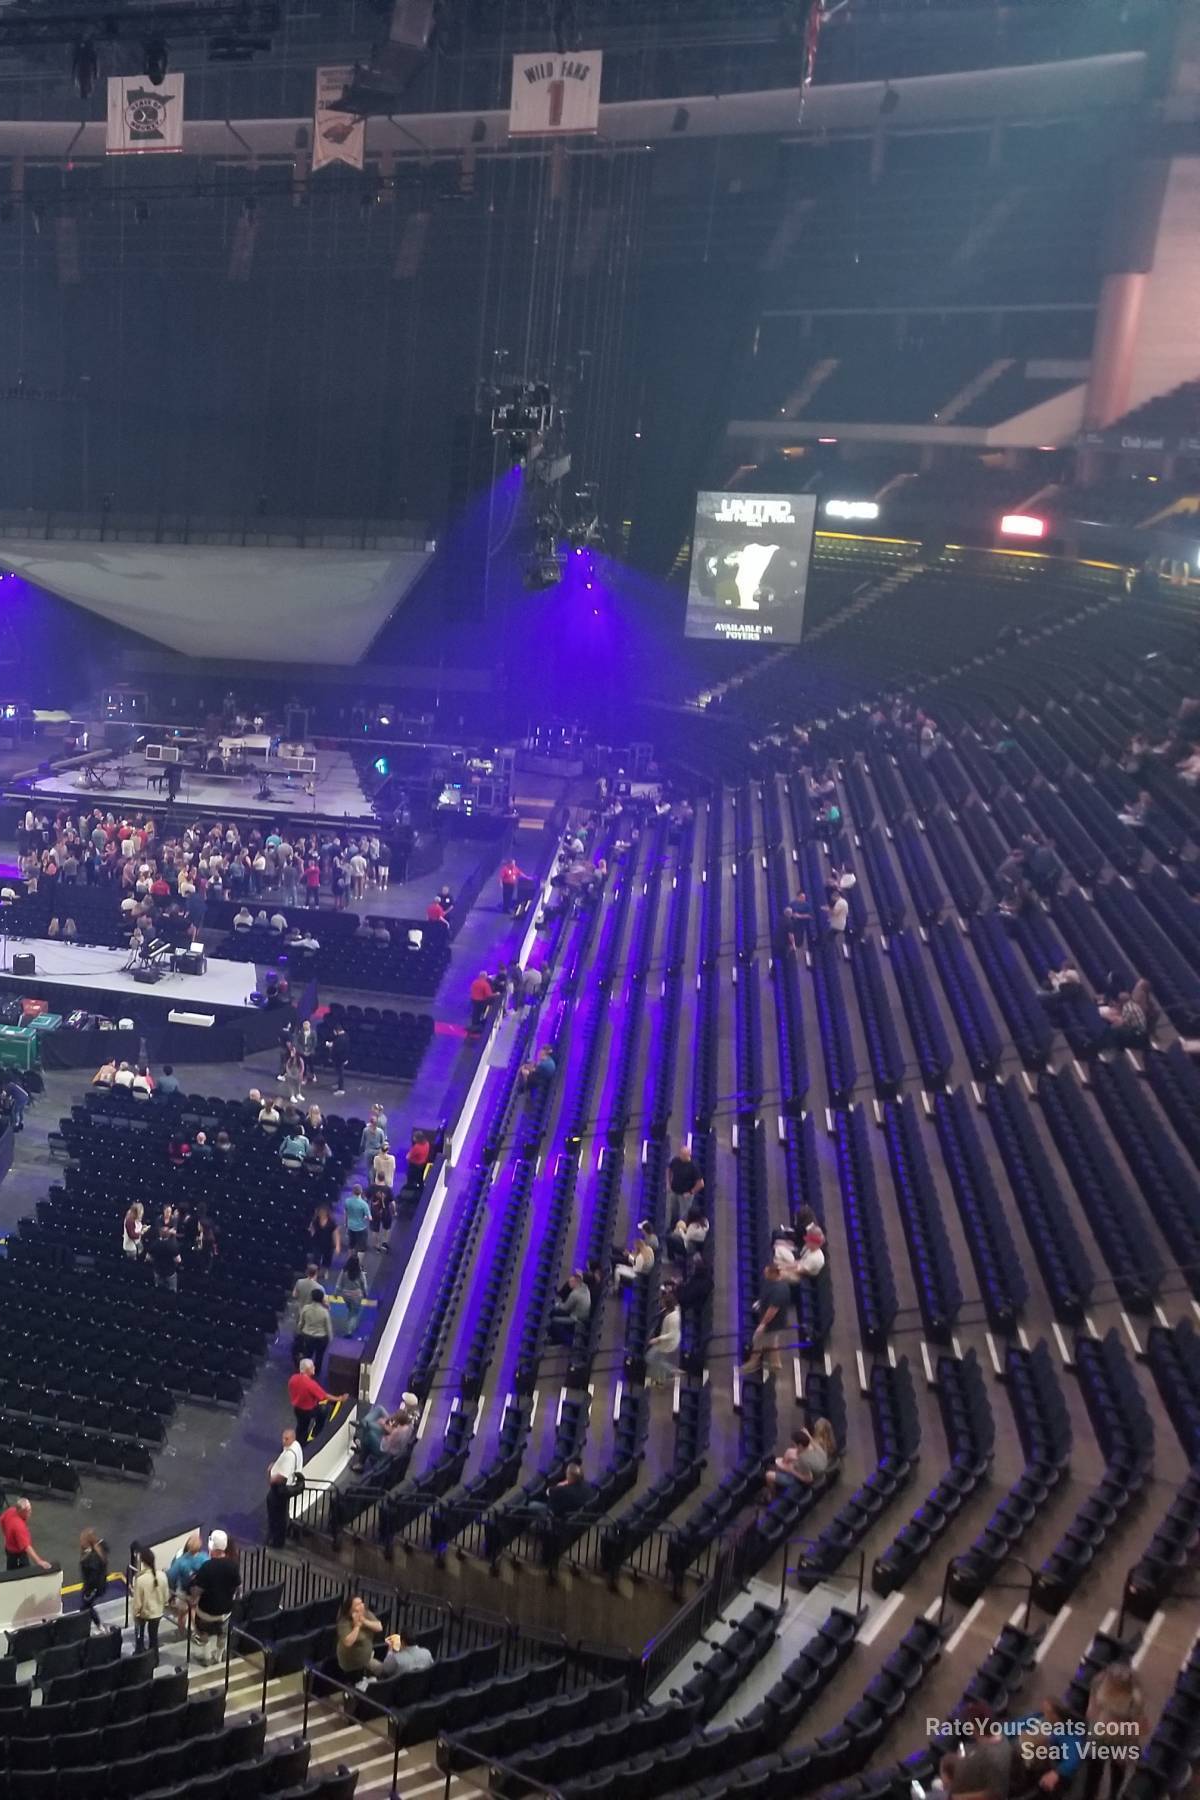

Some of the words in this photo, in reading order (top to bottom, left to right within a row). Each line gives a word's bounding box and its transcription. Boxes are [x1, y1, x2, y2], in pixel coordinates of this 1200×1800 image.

[523, 61, 554, 84] WILD
[561, 61, 590, 81] FANS
[547, 80, 564, 126] 1
[714, 623, 761, 634] AVAILABLE
[763, 625, 773, 635] IN
[725, 631, 760, 641] FOYERS
